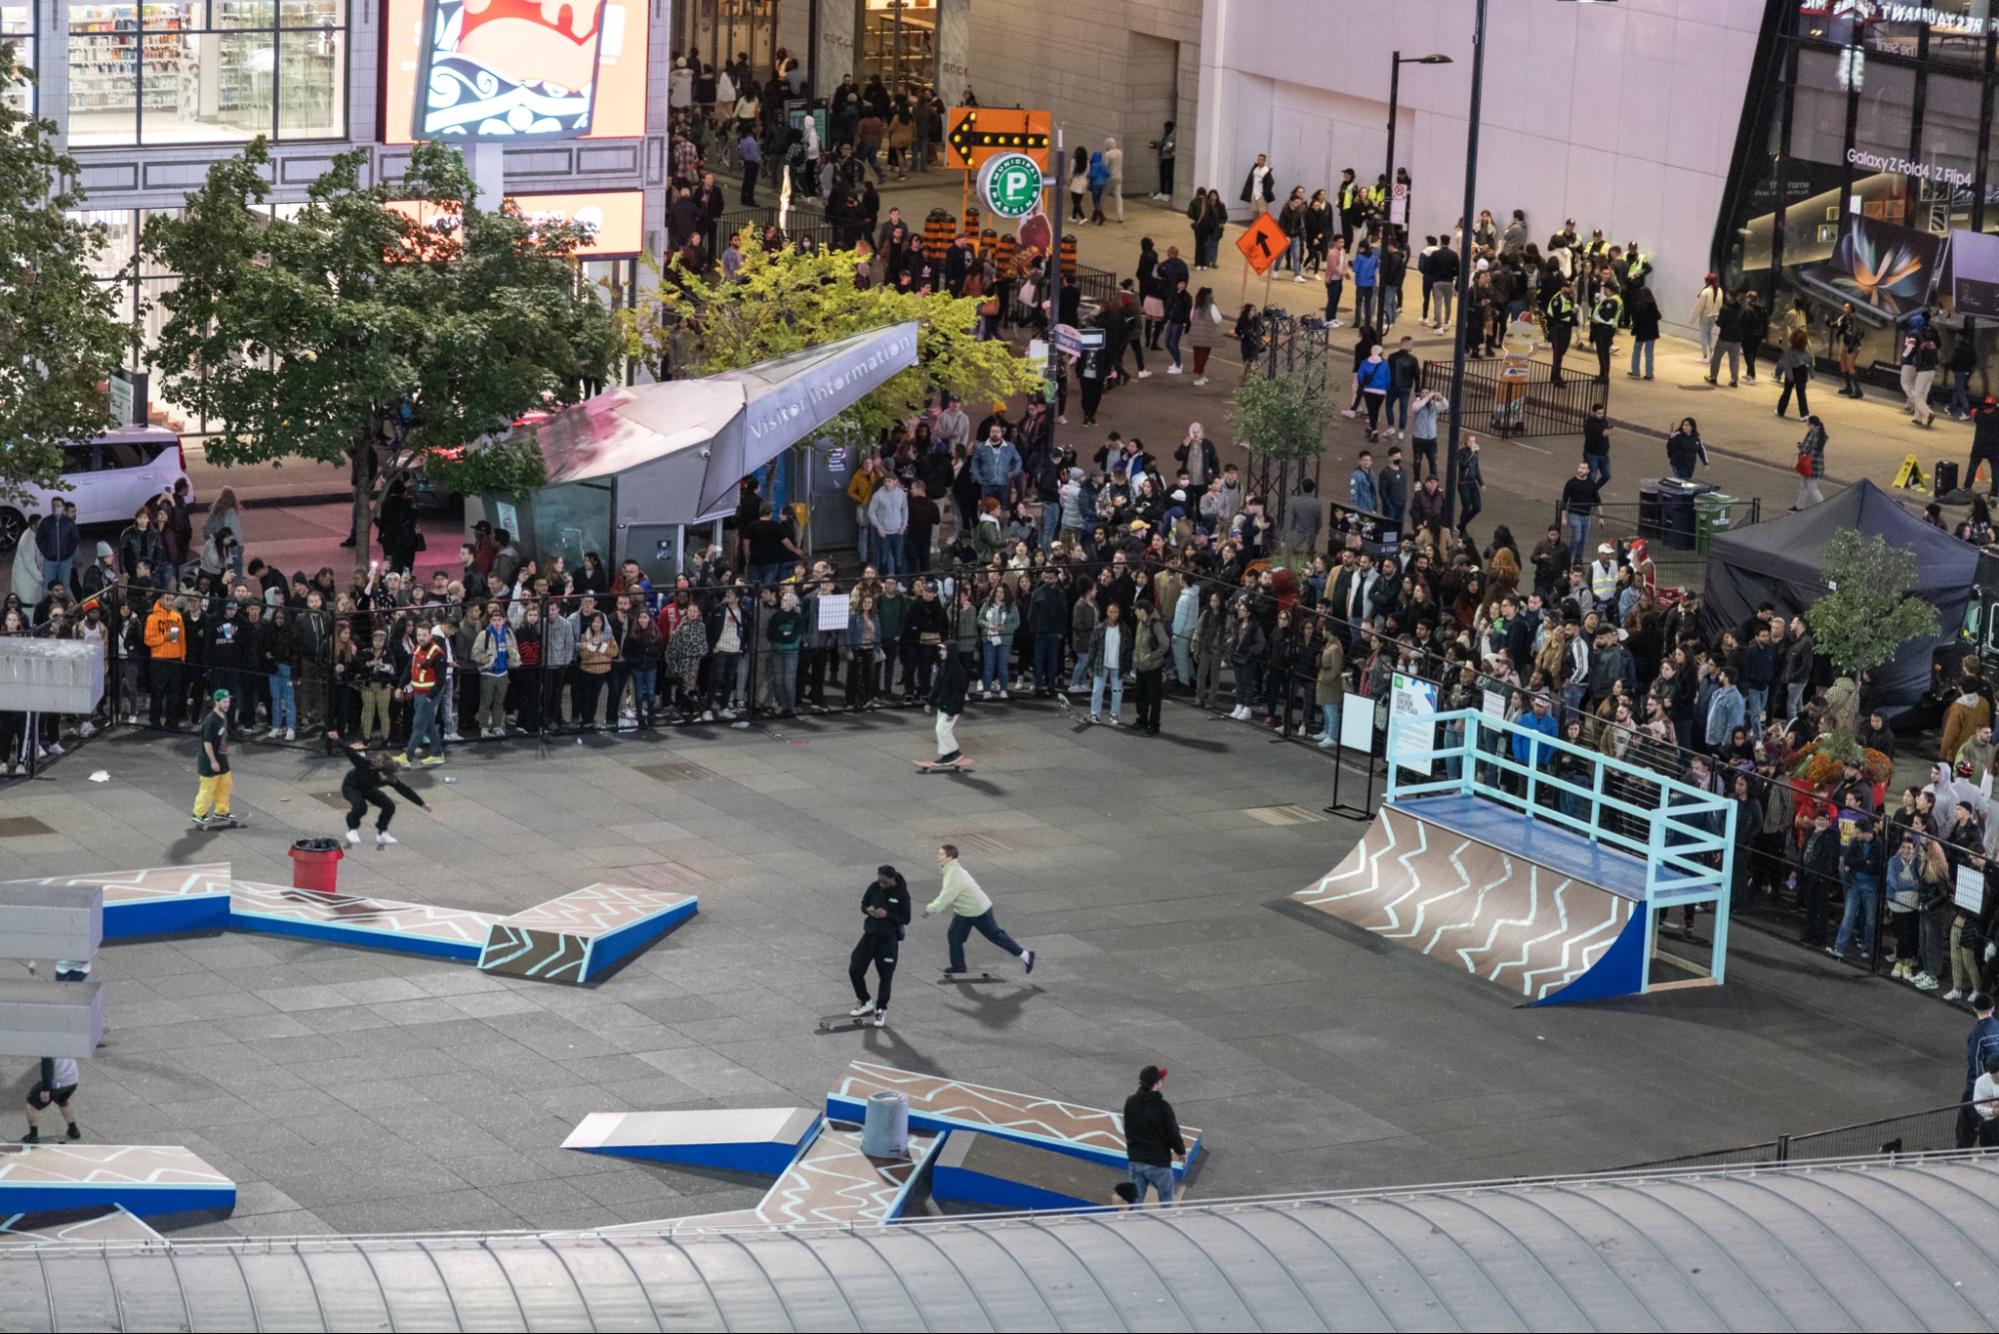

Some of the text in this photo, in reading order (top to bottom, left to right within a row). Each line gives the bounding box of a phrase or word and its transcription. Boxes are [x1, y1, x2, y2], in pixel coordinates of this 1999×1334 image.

[993, 158, 1039, 180] MUNICIPAL
[1846, 148, 1972, 187] Galaxy Z Fold4 Z Flip4
[1006, 172, 1028, 196] P
[992, 191, 1038, 214] PARKING
[749, 334, 912, 439] Visitor Information
